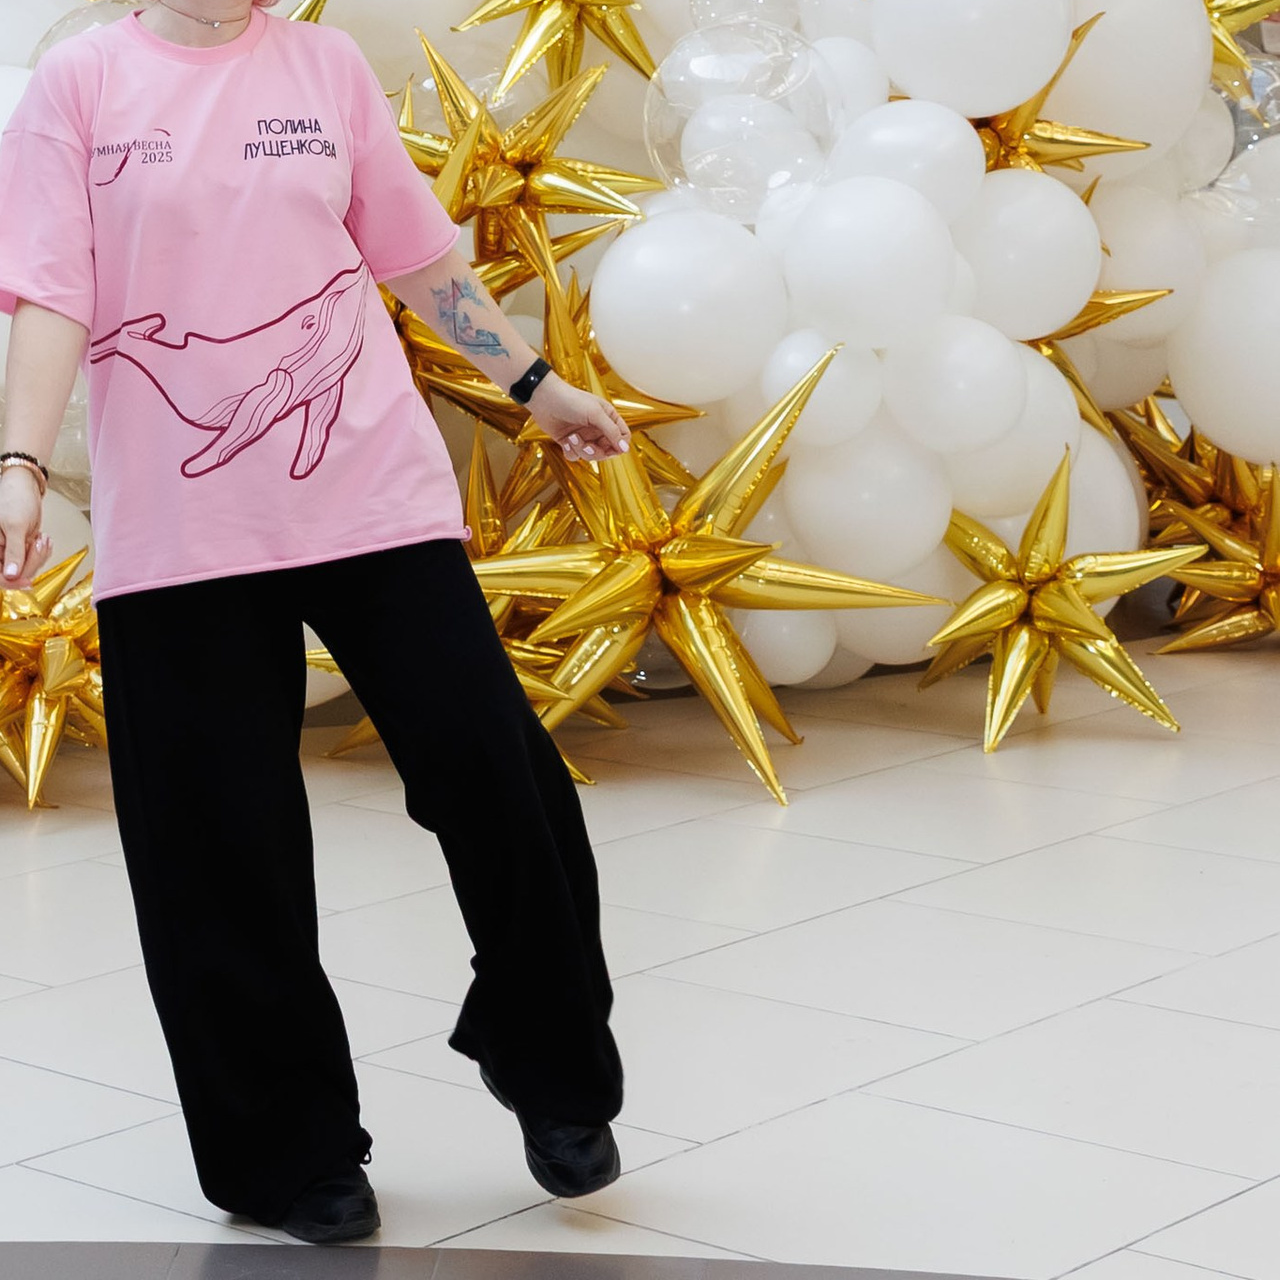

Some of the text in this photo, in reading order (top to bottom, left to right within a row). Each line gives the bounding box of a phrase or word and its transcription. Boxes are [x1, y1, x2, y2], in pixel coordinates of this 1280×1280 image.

[257, 118, 322, 135] ПОЛИНА
[133, 140, 172, 151] ВЕСНА
[244, 138, 337, 160] ЛУЩЕНКОВА
[141, 151, 173, 164] 2025
